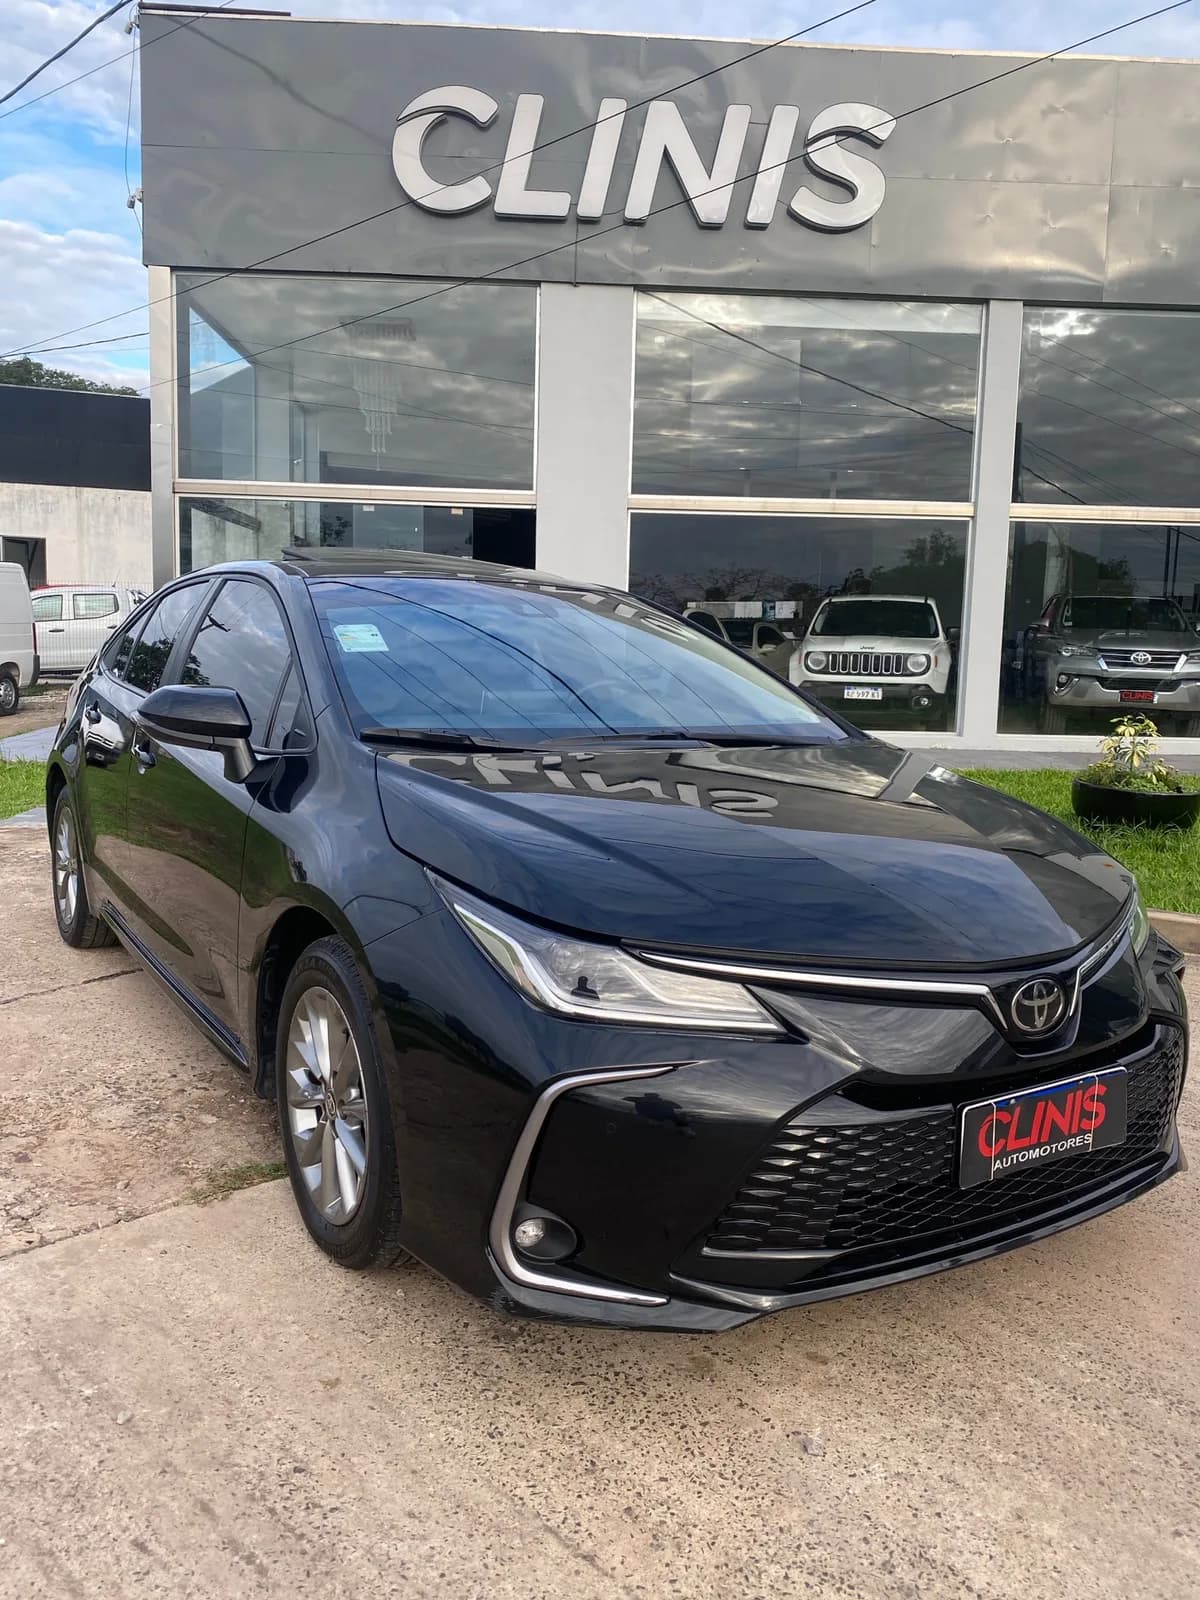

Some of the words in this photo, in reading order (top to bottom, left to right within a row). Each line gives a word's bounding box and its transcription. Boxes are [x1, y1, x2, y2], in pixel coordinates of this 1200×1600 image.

[391, 84, 898, 232] CLINIS
[978, 1084, 1107, 1157] CLINIS
[993, 1133, 1092, 1171] AUTOMOTORES
